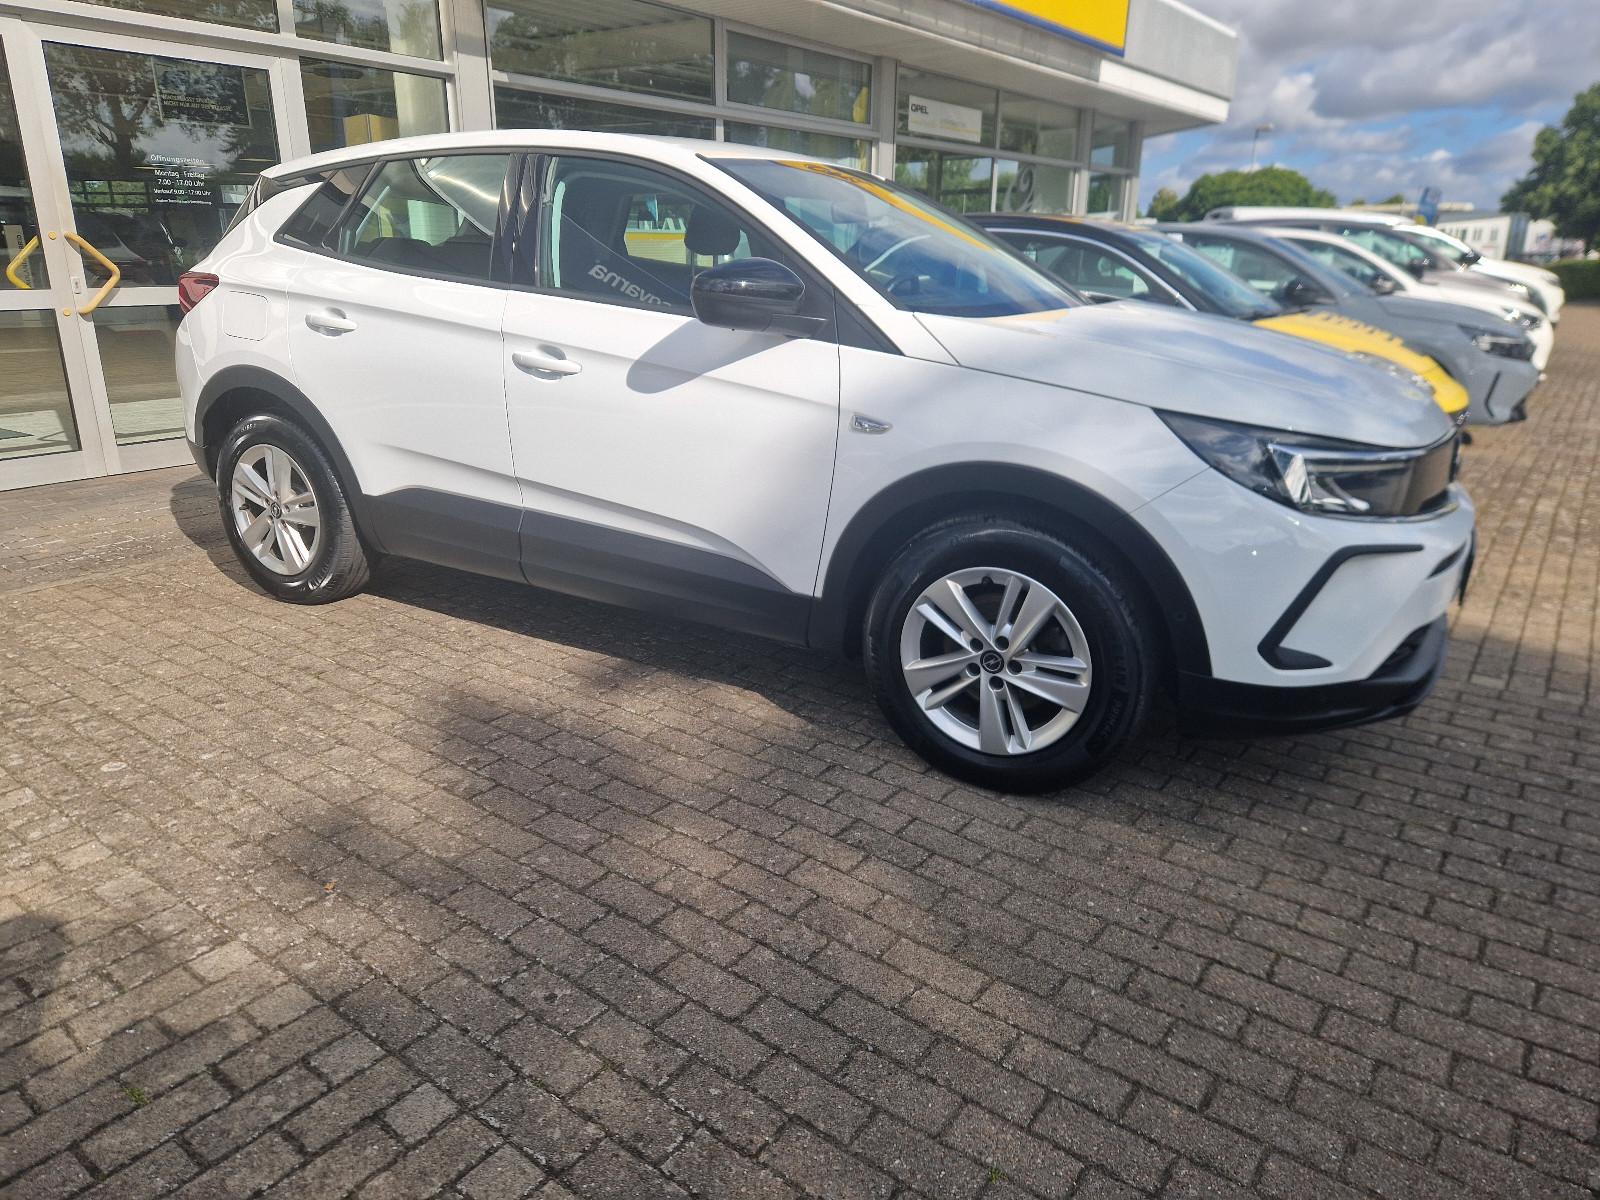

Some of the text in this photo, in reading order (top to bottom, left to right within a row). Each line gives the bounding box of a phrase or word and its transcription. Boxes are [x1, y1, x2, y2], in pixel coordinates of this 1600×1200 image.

[911, 103, 929, 114] OPEL
[154, 169, 180, 179] Montag
[183, 171, 205, 180] Freitag
